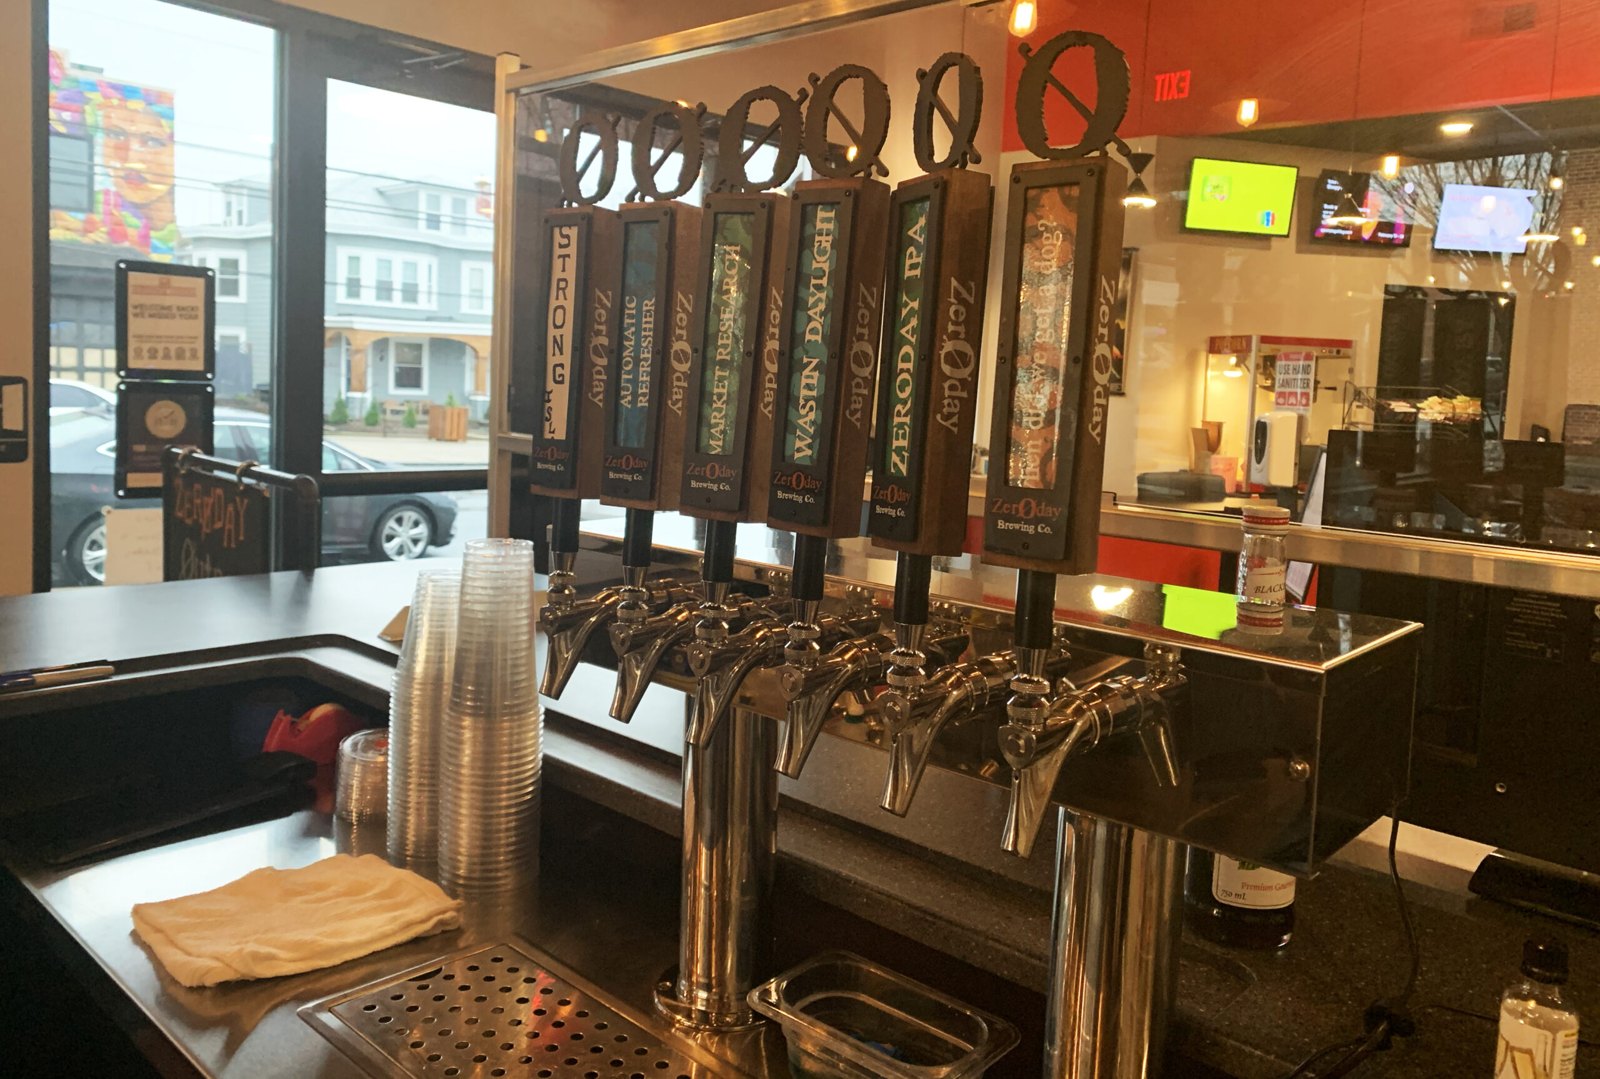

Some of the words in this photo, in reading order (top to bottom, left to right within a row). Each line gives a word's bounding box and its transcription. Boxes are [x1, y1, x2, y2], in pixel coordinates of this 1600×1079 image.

[904, 213, 928, 281] IPA
[551, 226, 572, 385] STRONG
[716, 243, 742, 361] RESEARCH
[619, 295, 637, 408] AUTOMATIC
[637, 297, 656, 408] REFRESHER
[1291, 363, 1312, 376] HAND
[891, 297, 920, 476] ZERODAY
[709, 366, 730, 454] MARKET
[794, 355, 821, 461] WASTIN
[608, 471, 633, 482] Brewing
[690, 480, 718, 491] Brewing
[777, 490, 803, 504] Brewing
[875, 504, 896, 518] Brewing
[997, 519, 1035, 535] Brewing
[1221, 888, 1233, 898] 750
[1241, 881, 1274, 892] Premium
